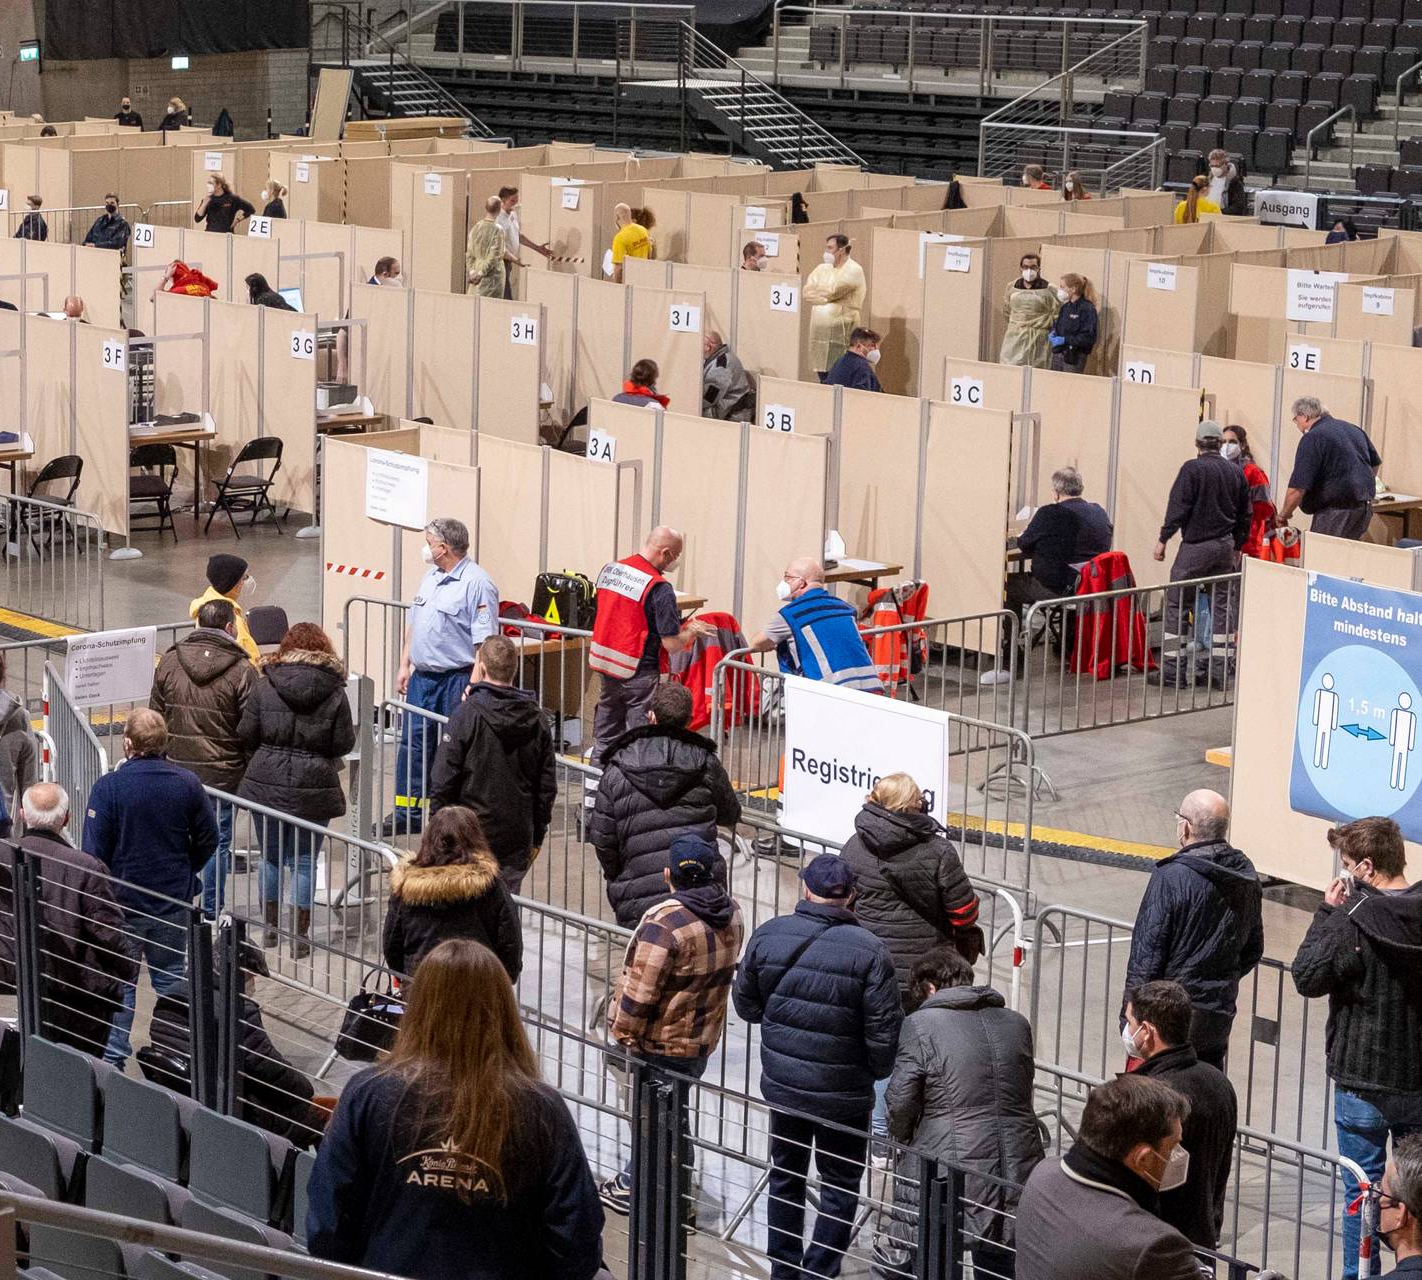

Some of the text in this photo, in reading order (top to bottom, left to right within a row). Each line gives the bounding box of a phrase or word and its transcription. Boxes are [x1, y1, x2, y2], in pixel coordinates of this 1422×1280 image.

[1260, 200, 1309, 218] Ausgang
[1309, 588, 1338, 607] Bitte
[1341, 596, 1393, 620] Abstand
[71, 636, 147, 652] Corona-Schutzimpfung
[1333, 620, 1407, 647] mindestens
[1348, 697, 1386, 720] 1,5 m
[406, 1170, 490, 1193] ARENA
